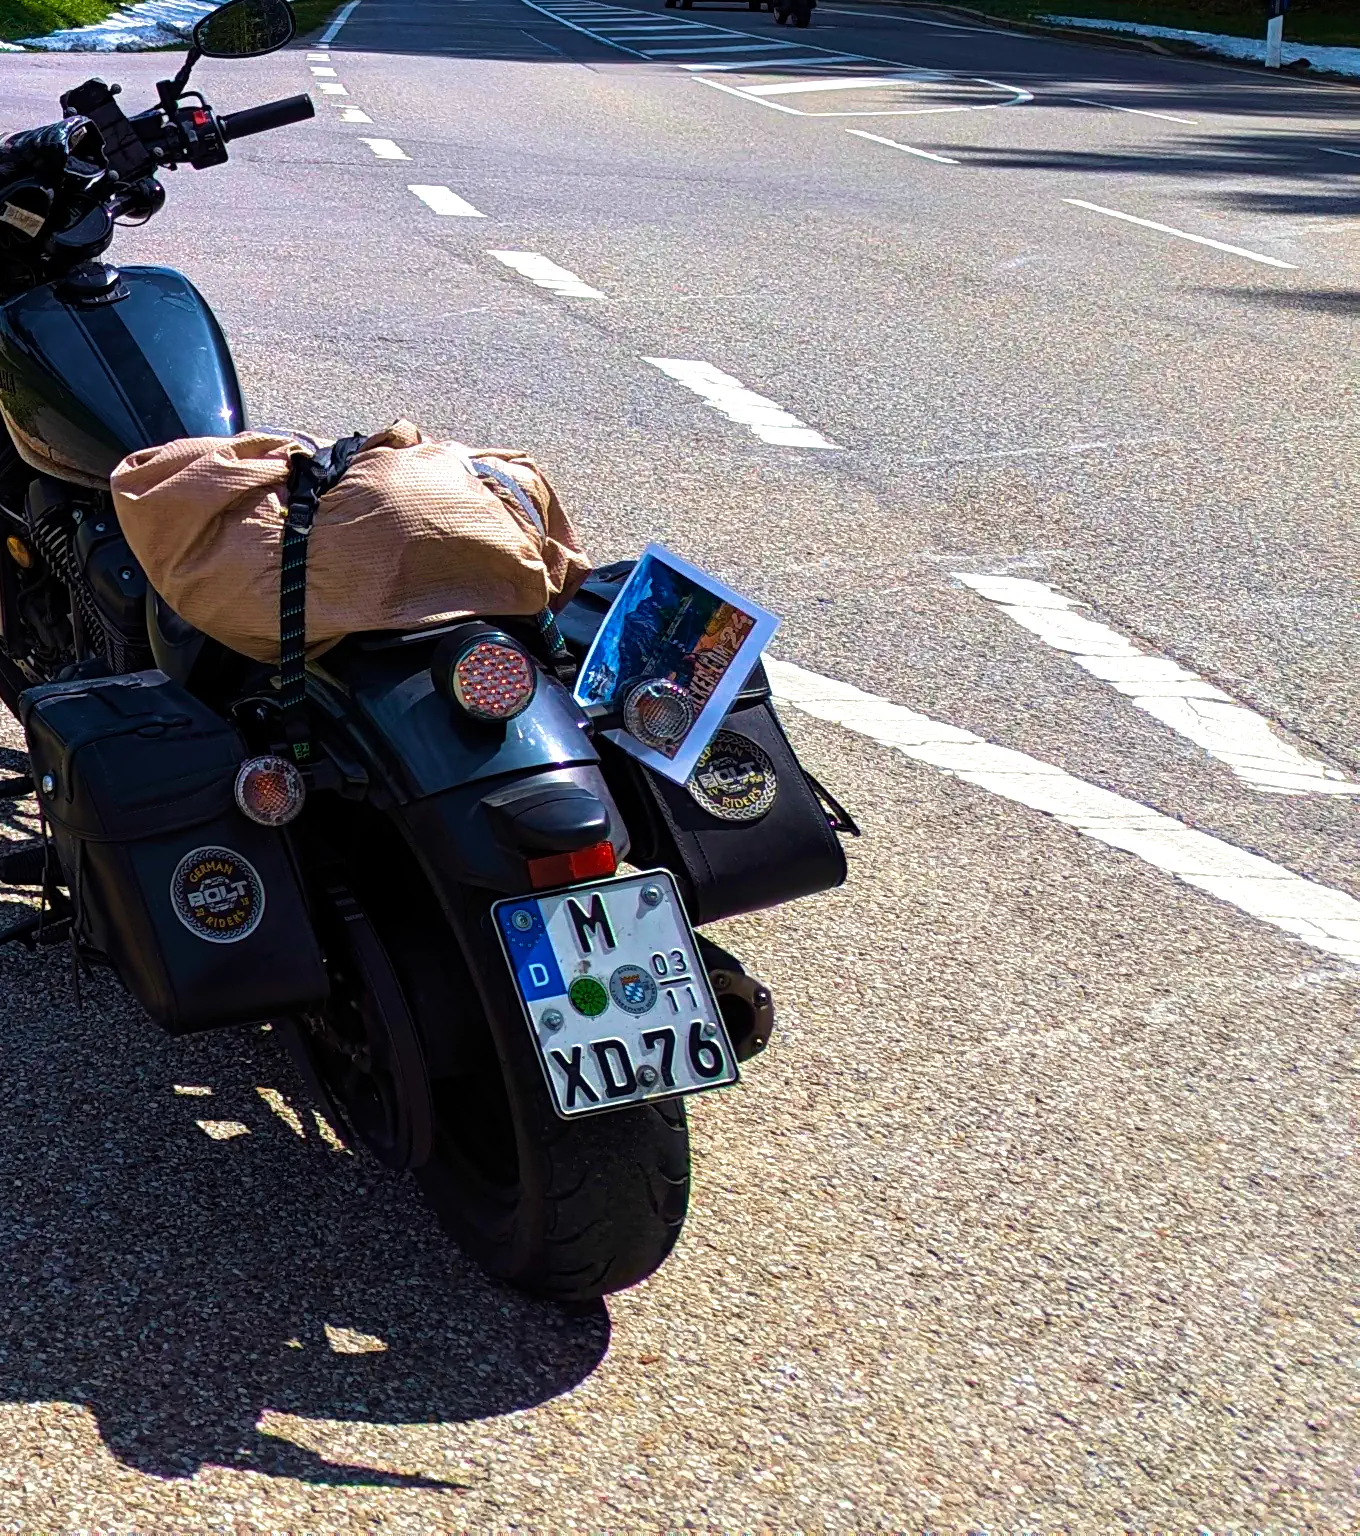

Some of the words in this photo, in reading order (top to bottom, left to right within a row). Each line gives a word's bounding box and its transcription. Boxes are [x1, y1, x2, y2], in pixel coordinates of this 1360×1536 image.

[721, 787, 762, 809] RIDERS
[189, 861, 233, 882] GERMAN
[187, 880, 248, 908] BOLT
[205, 909, 246, 928] RIDERS
[566, 893, 616, 953] M
[528, 963, 550, 988] D
[652, 950, 687, 976] 03
[666, 987, 699, 1013] 11
[549, 1037, 639, 1108] XD
[641, 1021, 725, 1087] 76
